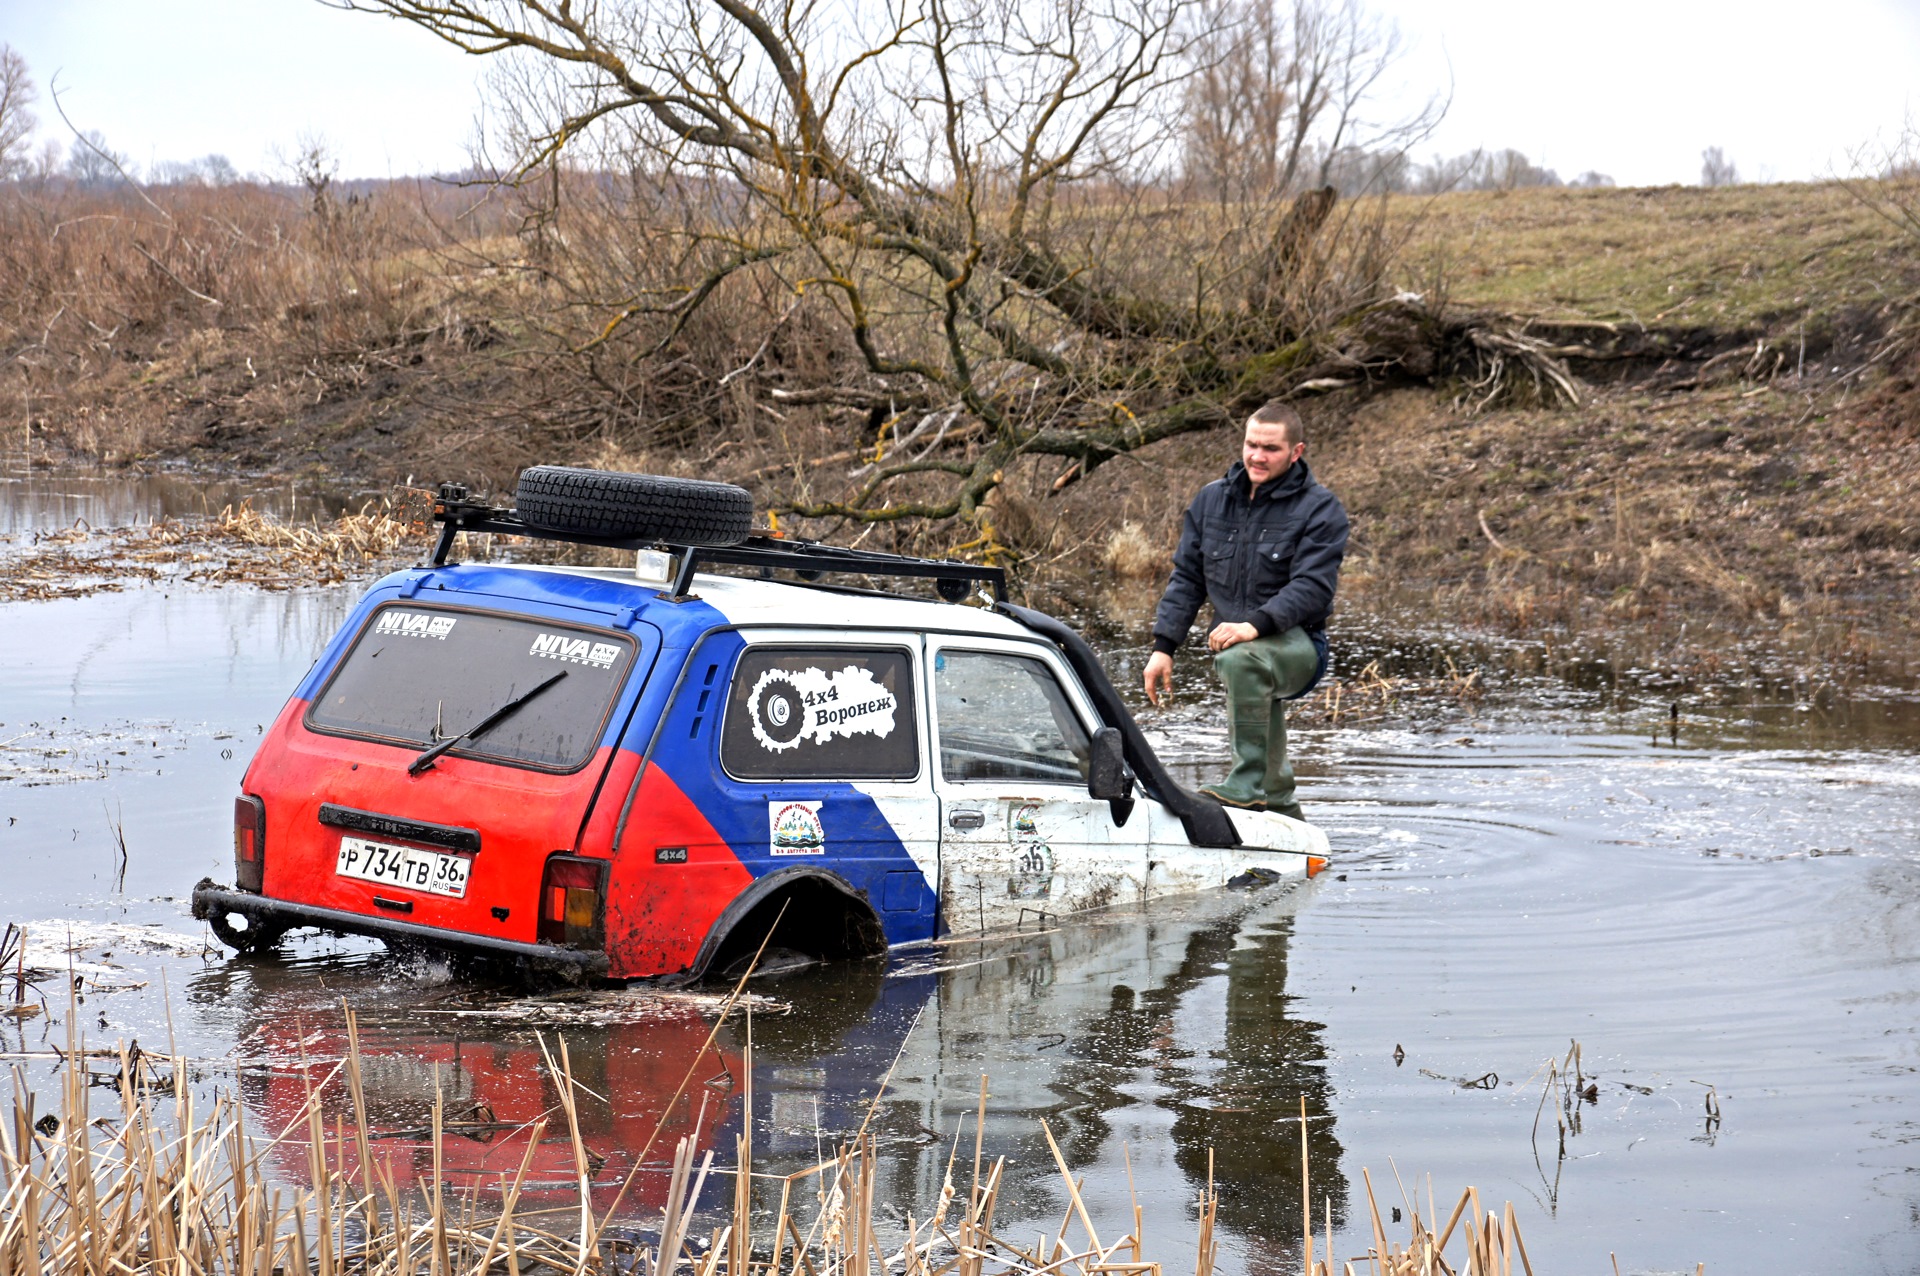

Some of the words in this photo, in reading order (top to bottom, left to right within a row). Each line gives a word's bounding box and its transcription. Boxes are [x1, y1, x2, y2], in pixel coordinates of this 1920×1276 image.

[377, 611, 430, 632] NIVA
[530, 633, 591, 658] NIVA
[815, 696, 892, 726] Воронеж
[432, 880, 449, 891] RUS
